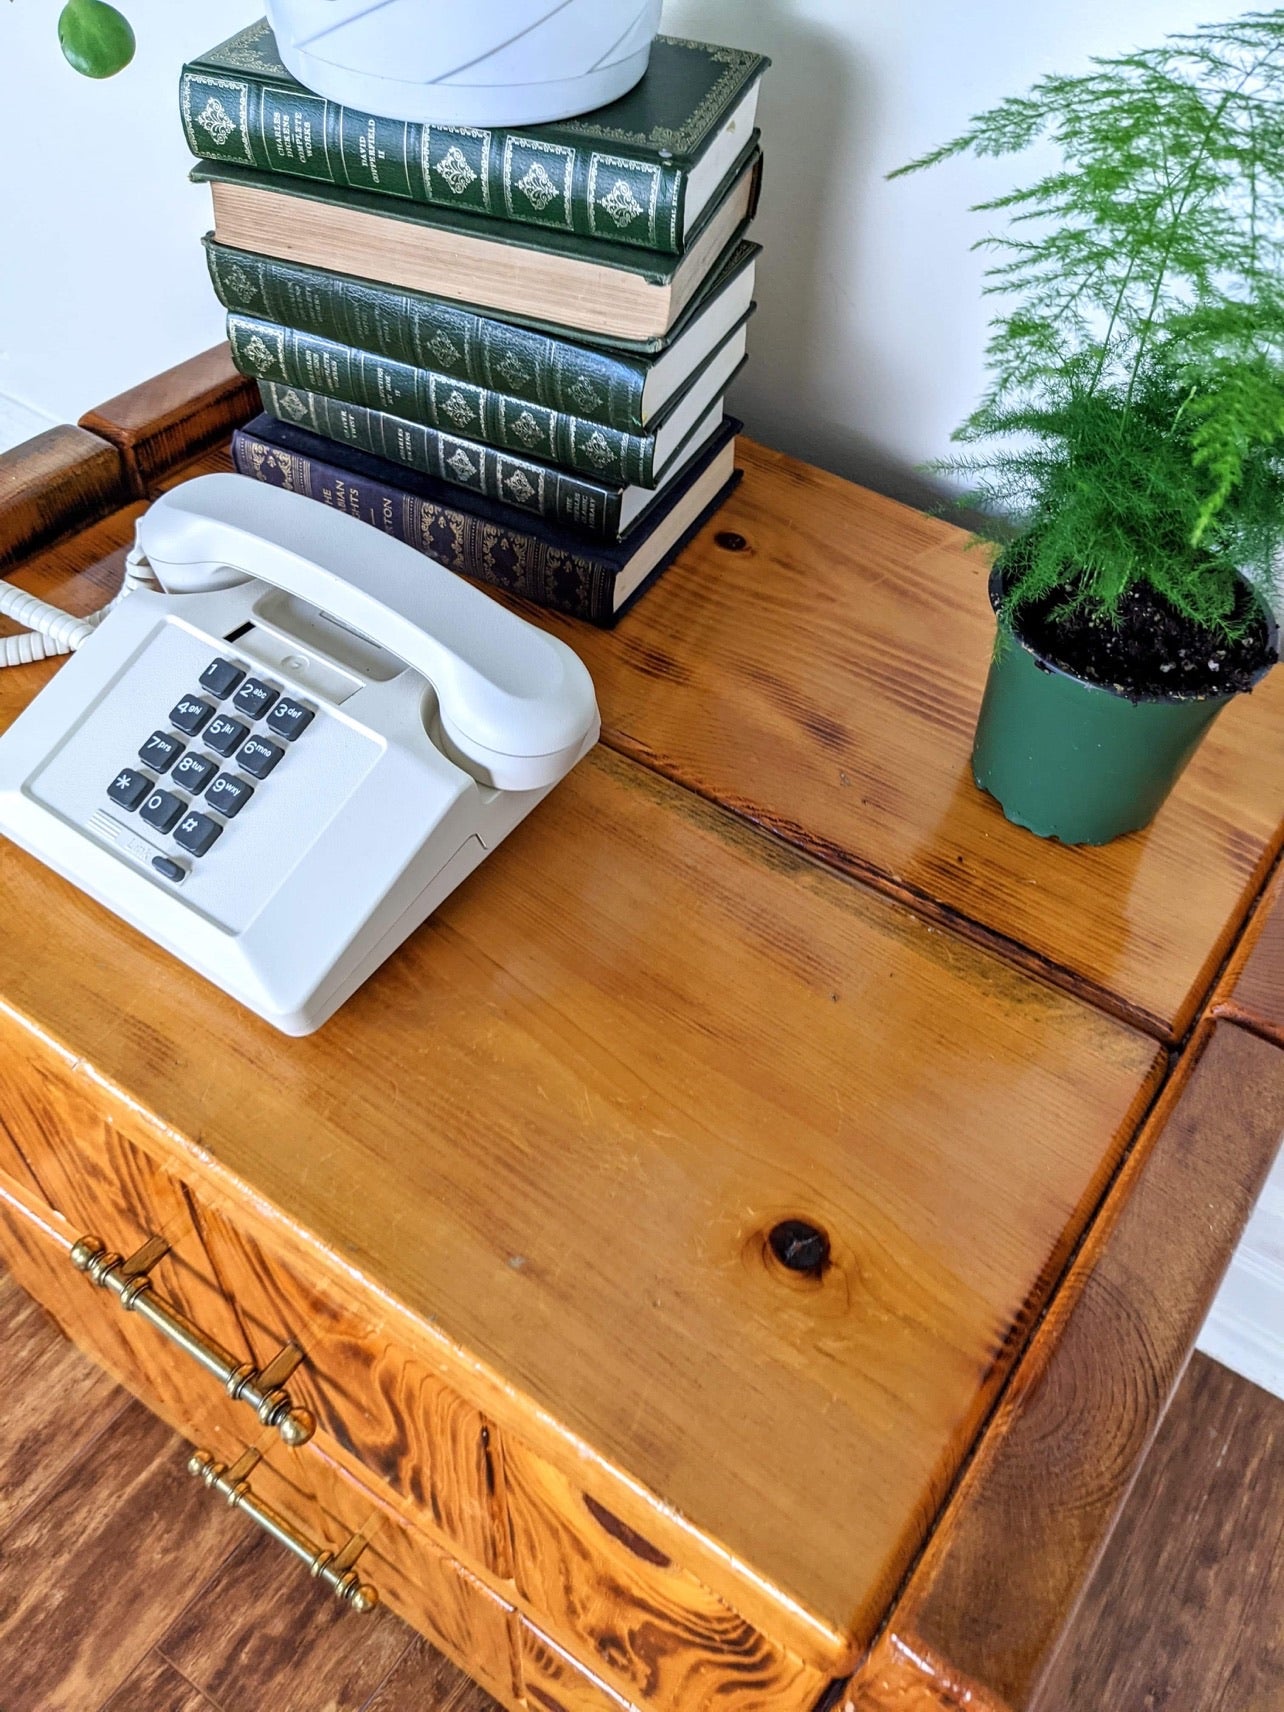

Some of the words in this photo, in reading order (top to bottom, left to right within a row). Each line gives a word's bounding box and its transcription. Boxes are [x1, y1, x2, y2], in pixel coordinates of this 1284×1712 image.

[273, 112, 285, 157] CHARLES
[282, 114, 294, 158] DICKENS
[295, 112, 307, 163] COMPLETE
[303, 121, 313, 158] WORKS
[359, 136, 369, 167] DAVID
[368, 119, 380, 184] COPPERFIELD
[322, 488, 333, 505] HE
[349, 488, 361, 520] GHTS
[208, 663, 218, 675] 1
